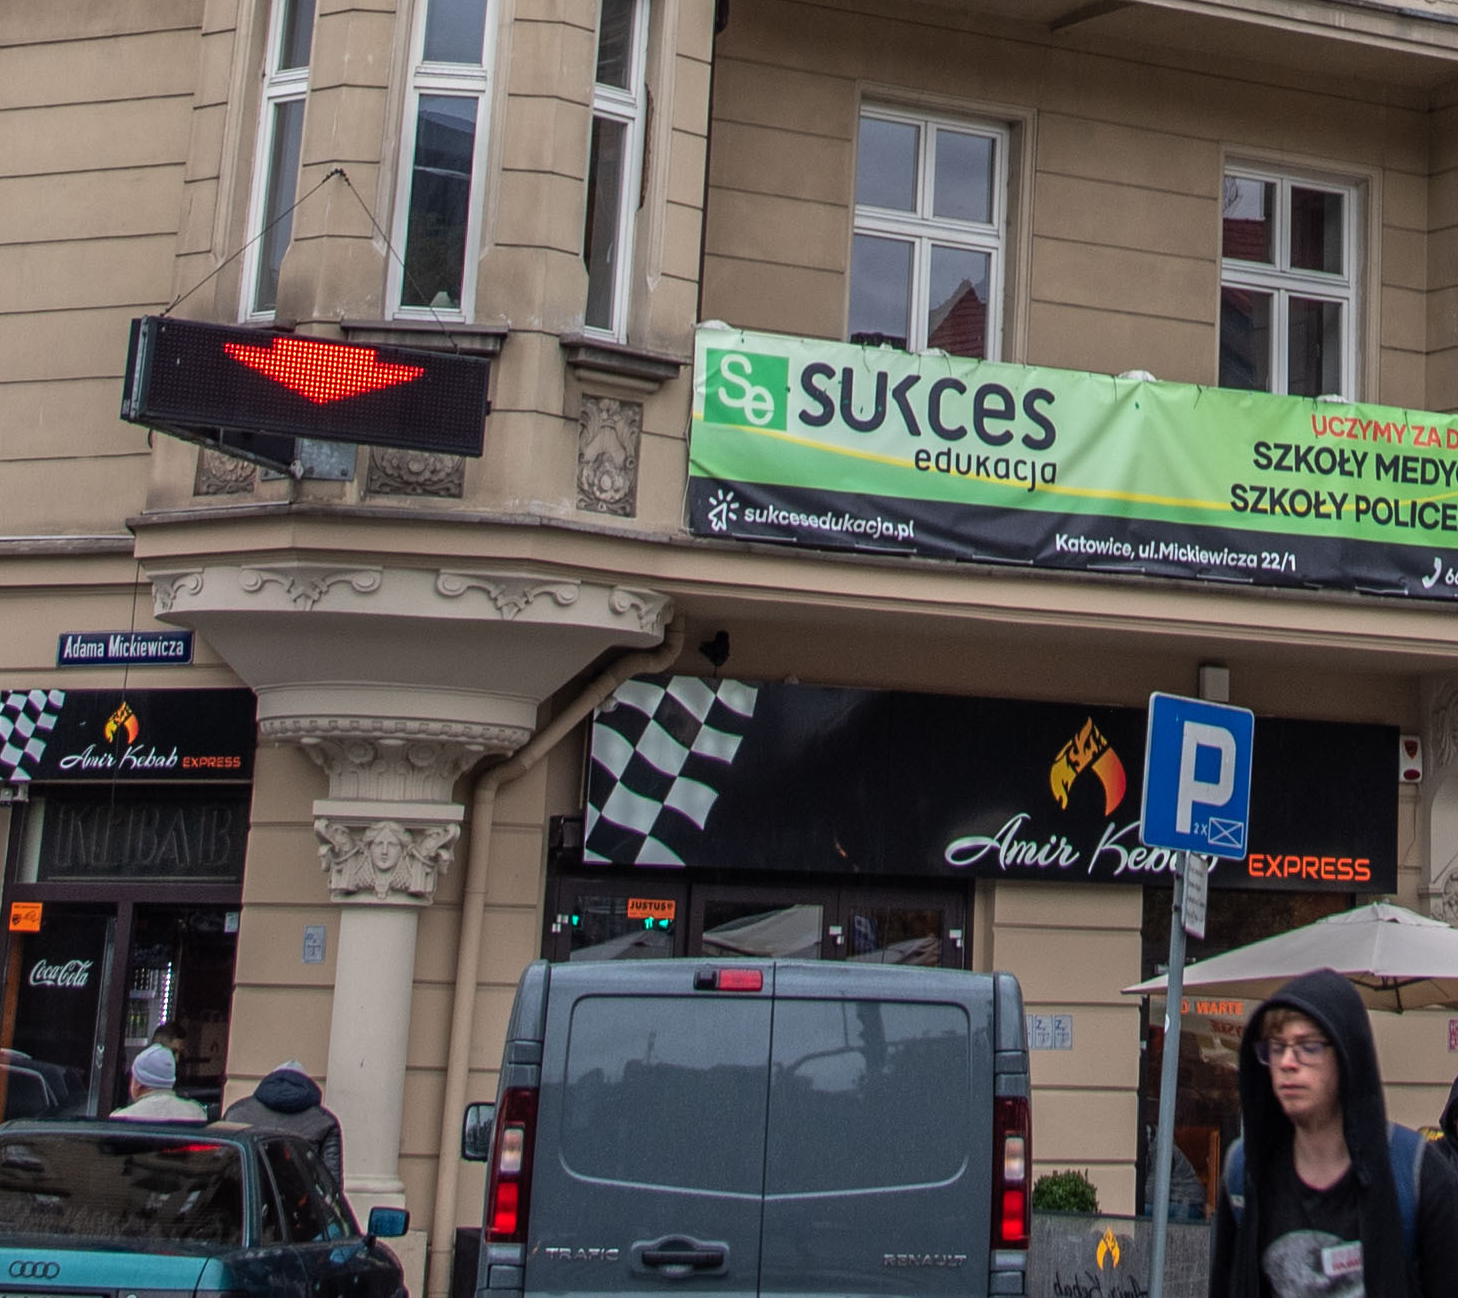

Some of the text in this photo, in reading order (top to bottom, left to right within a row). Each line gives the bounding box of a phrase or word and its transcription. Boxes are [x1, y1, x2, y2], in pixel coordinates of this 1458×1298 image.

[1311, 414, 1409, 446] UCZYMY
[1412, 424, 1442, 448] ZA
[915, 447, 1057, 493] edukacja
[1253, 441, 1367, 478] SZKOŁY
[1230, 483, 1349, 521] SZKOŁY
[744, 506, 915, 539] sukcesedukacja.pl
[1055, 534, 1135, 560] Katowice,
[1261, 551, 1296, 572] 22/1
[64, 634, 184, 659] Adama Mickiewicza
[60, 744, 241, 770] Amir Kebab EXPRESS
[1176, 720, 1237, 833] P
[945, 812, 1371, 881] Amir EXPRESS
[545, 1246, 619, 1262] TRAFIC
[883, 1253, 967, 1268] RENAULT
